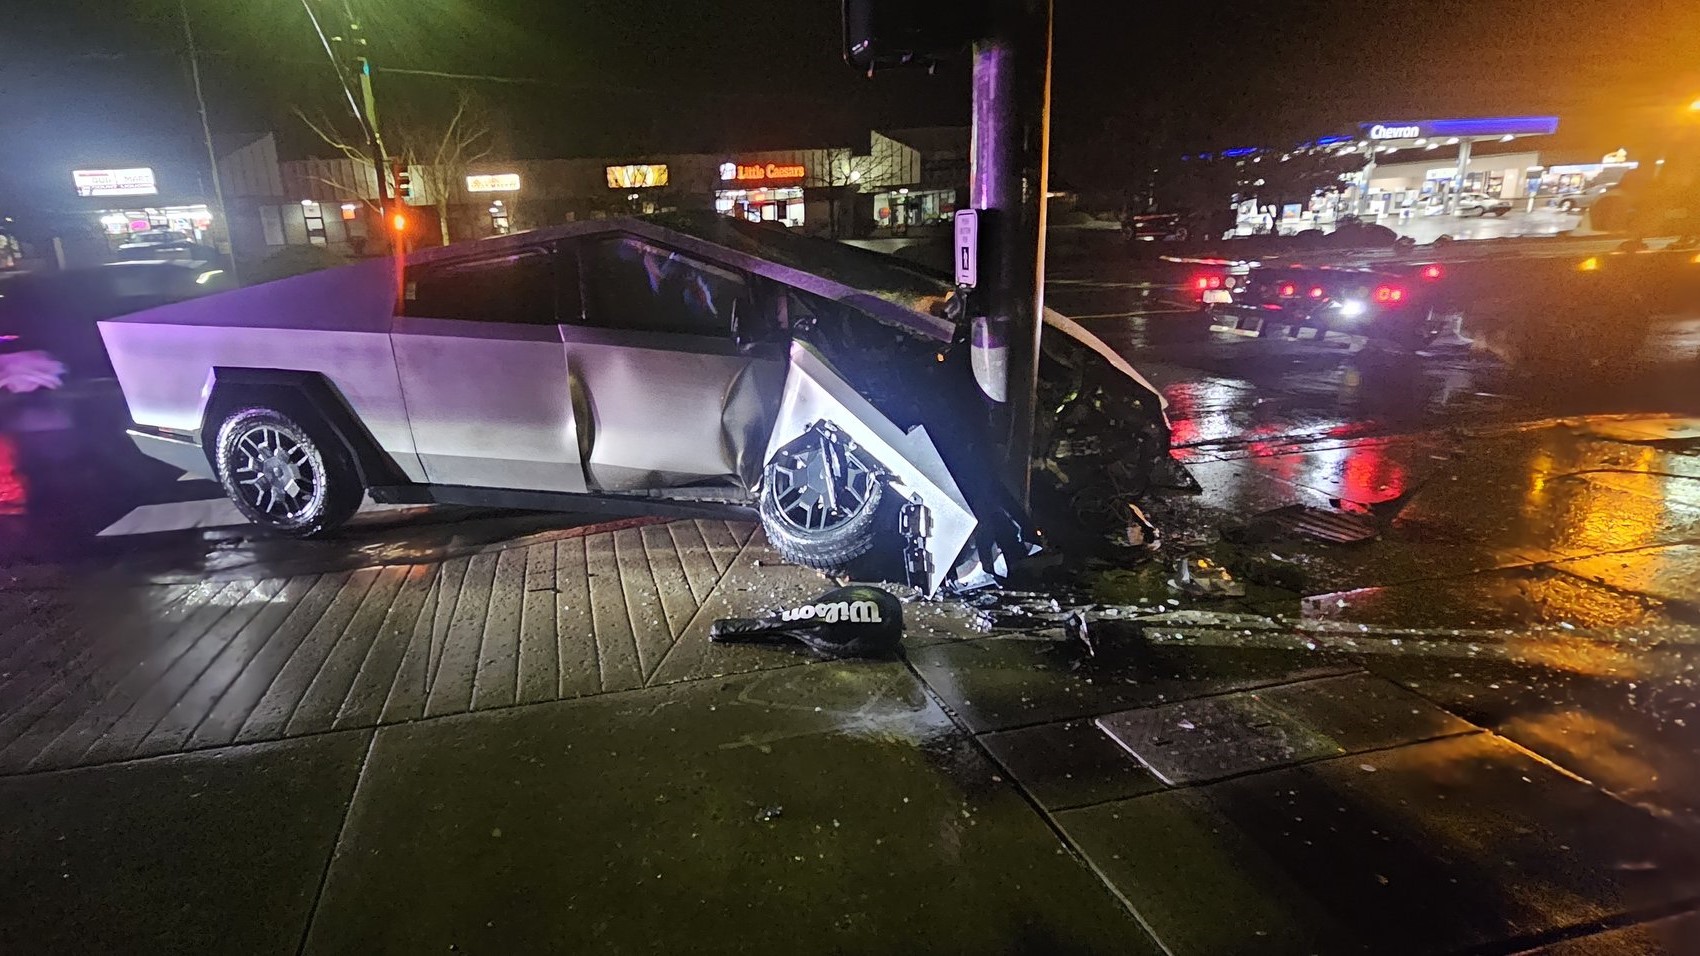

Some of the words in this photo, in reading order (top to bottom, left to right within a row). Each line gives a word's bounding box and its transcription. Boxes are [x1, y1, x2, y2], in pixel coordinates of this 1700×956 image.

[1370, 124, 1420, 139] Chevron
[736, 164, 765, 180] Little
[765, 163, 805, 179] Caesars
[782, 600, 882, 623] Wilson
